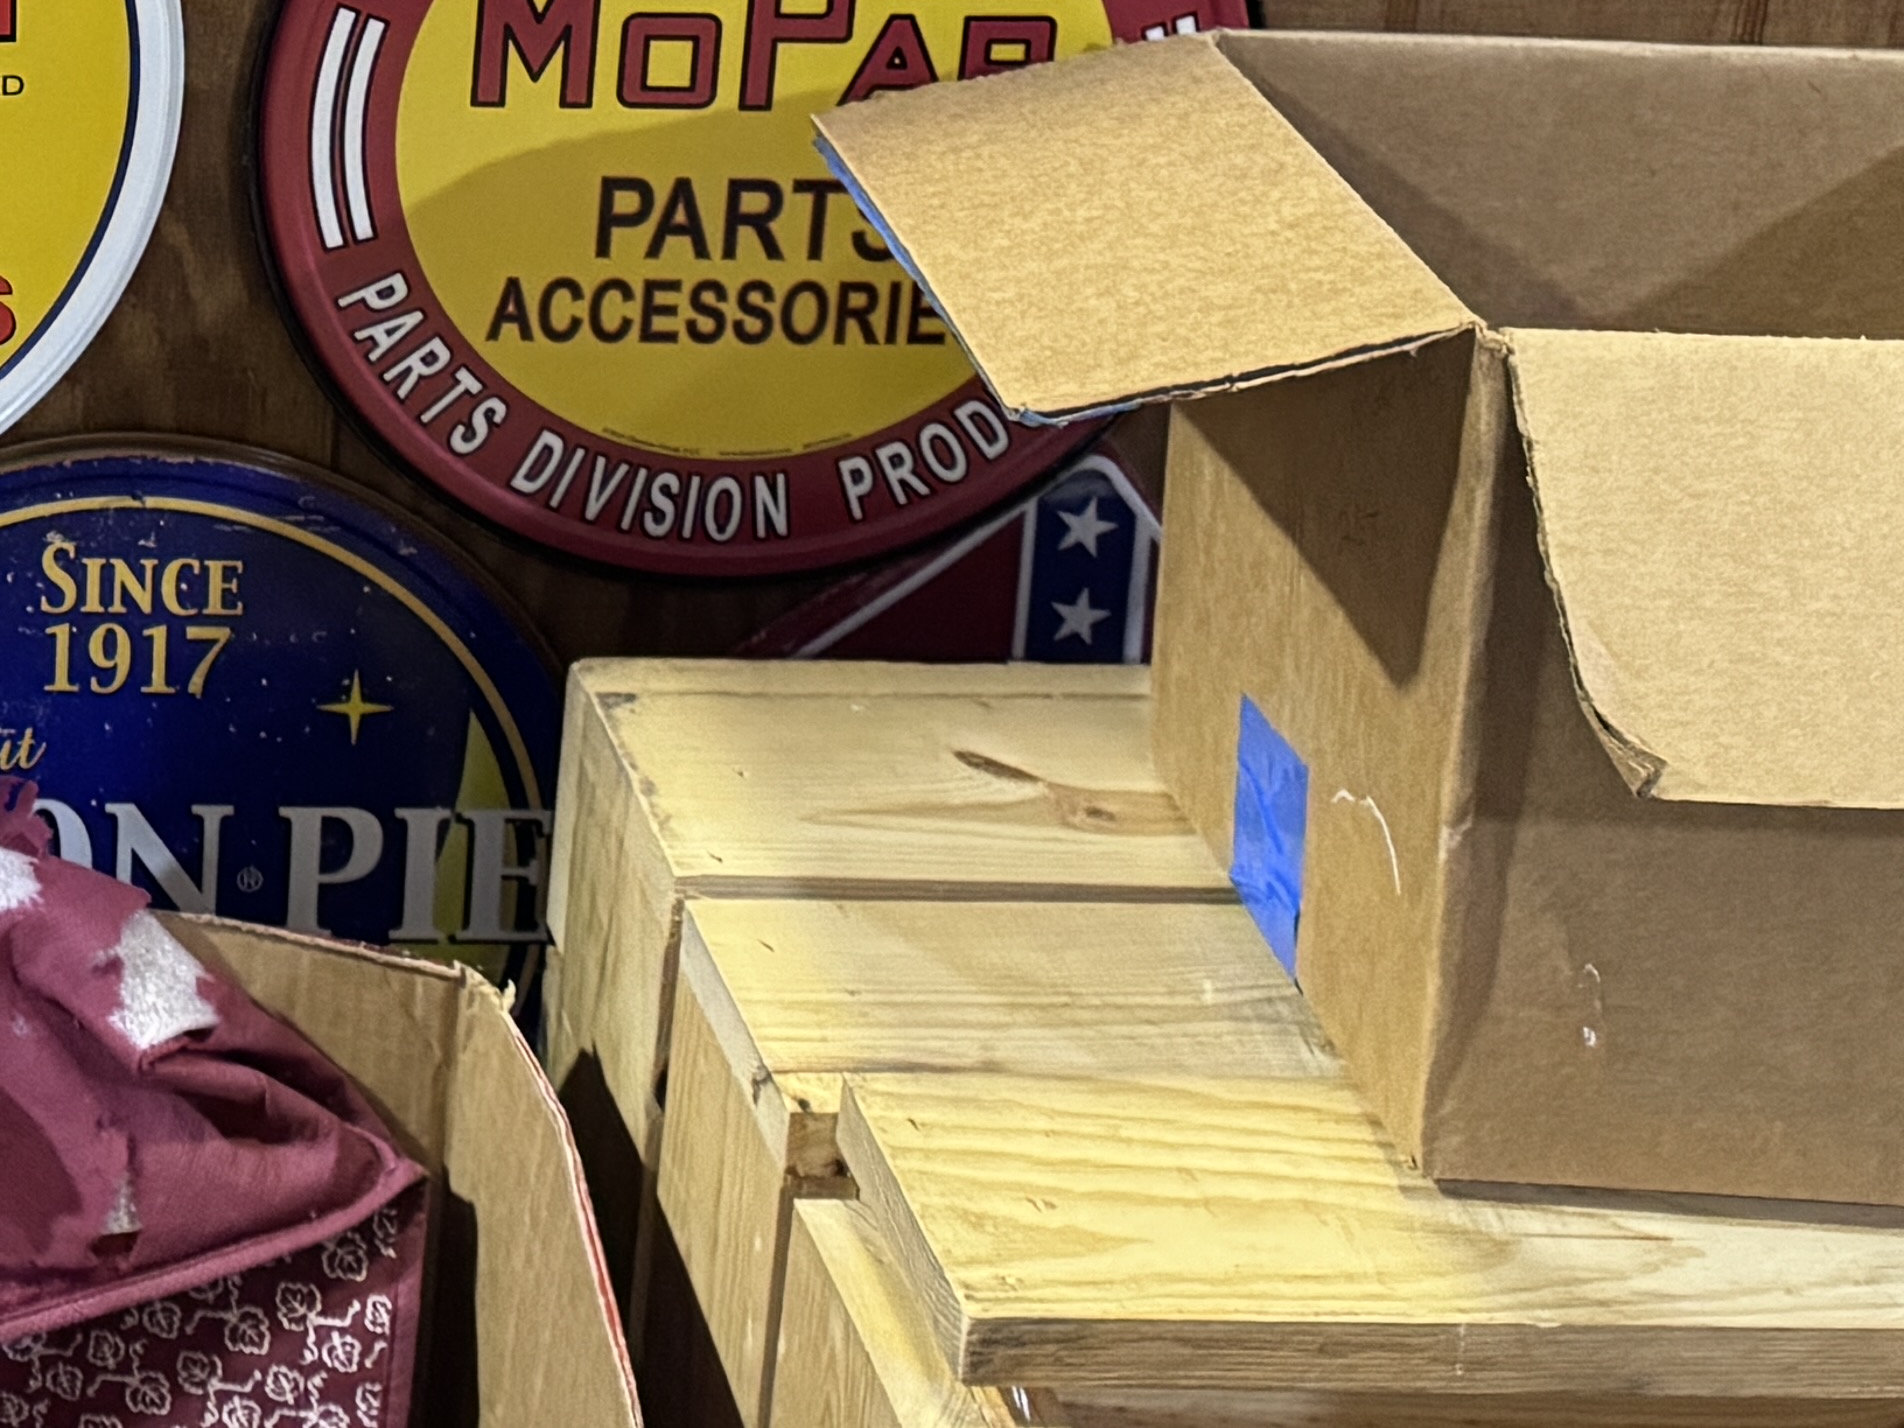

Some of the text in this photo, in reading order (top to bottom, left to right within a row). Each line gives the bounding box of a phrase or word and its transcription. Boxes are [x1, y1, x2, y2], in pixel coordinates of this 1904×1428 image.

[337, 271, 790, 541] PARTS DIVISION
[38, 541, 245, 618] SINCE
[43, 623, 234, 696] 1917
[277, 804, 548, 944] PIE
